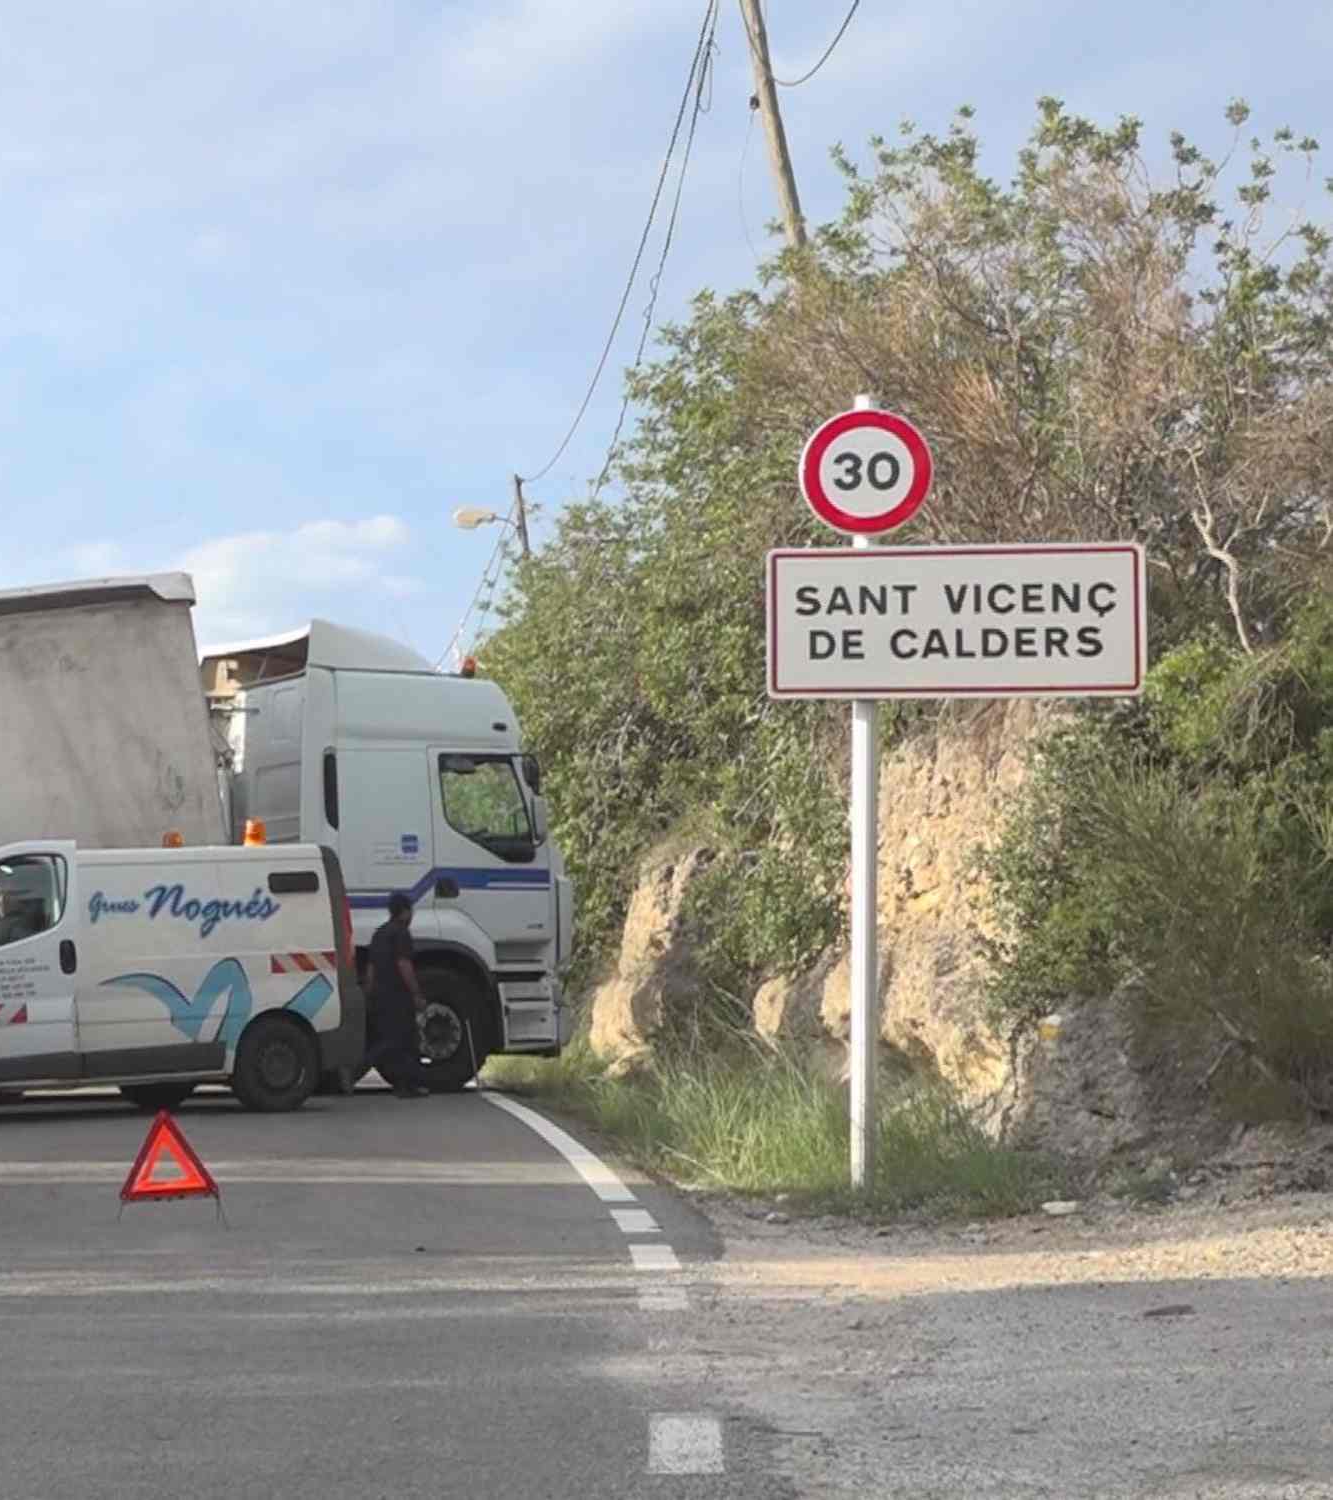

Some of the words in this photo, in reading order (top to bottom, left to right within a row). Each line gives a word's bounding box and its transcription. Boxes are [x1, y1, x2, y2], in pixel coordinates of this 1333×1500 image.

[832, 452, 900, 491] 30
[795, 584, 917, 616] SANT
[944, 582, 1117, 618] VICENÇ
[809, 630, 864, 660] DE
[890, 626, 1103, 660] CALDERS
[143, 883, 281, 938] Nogués
